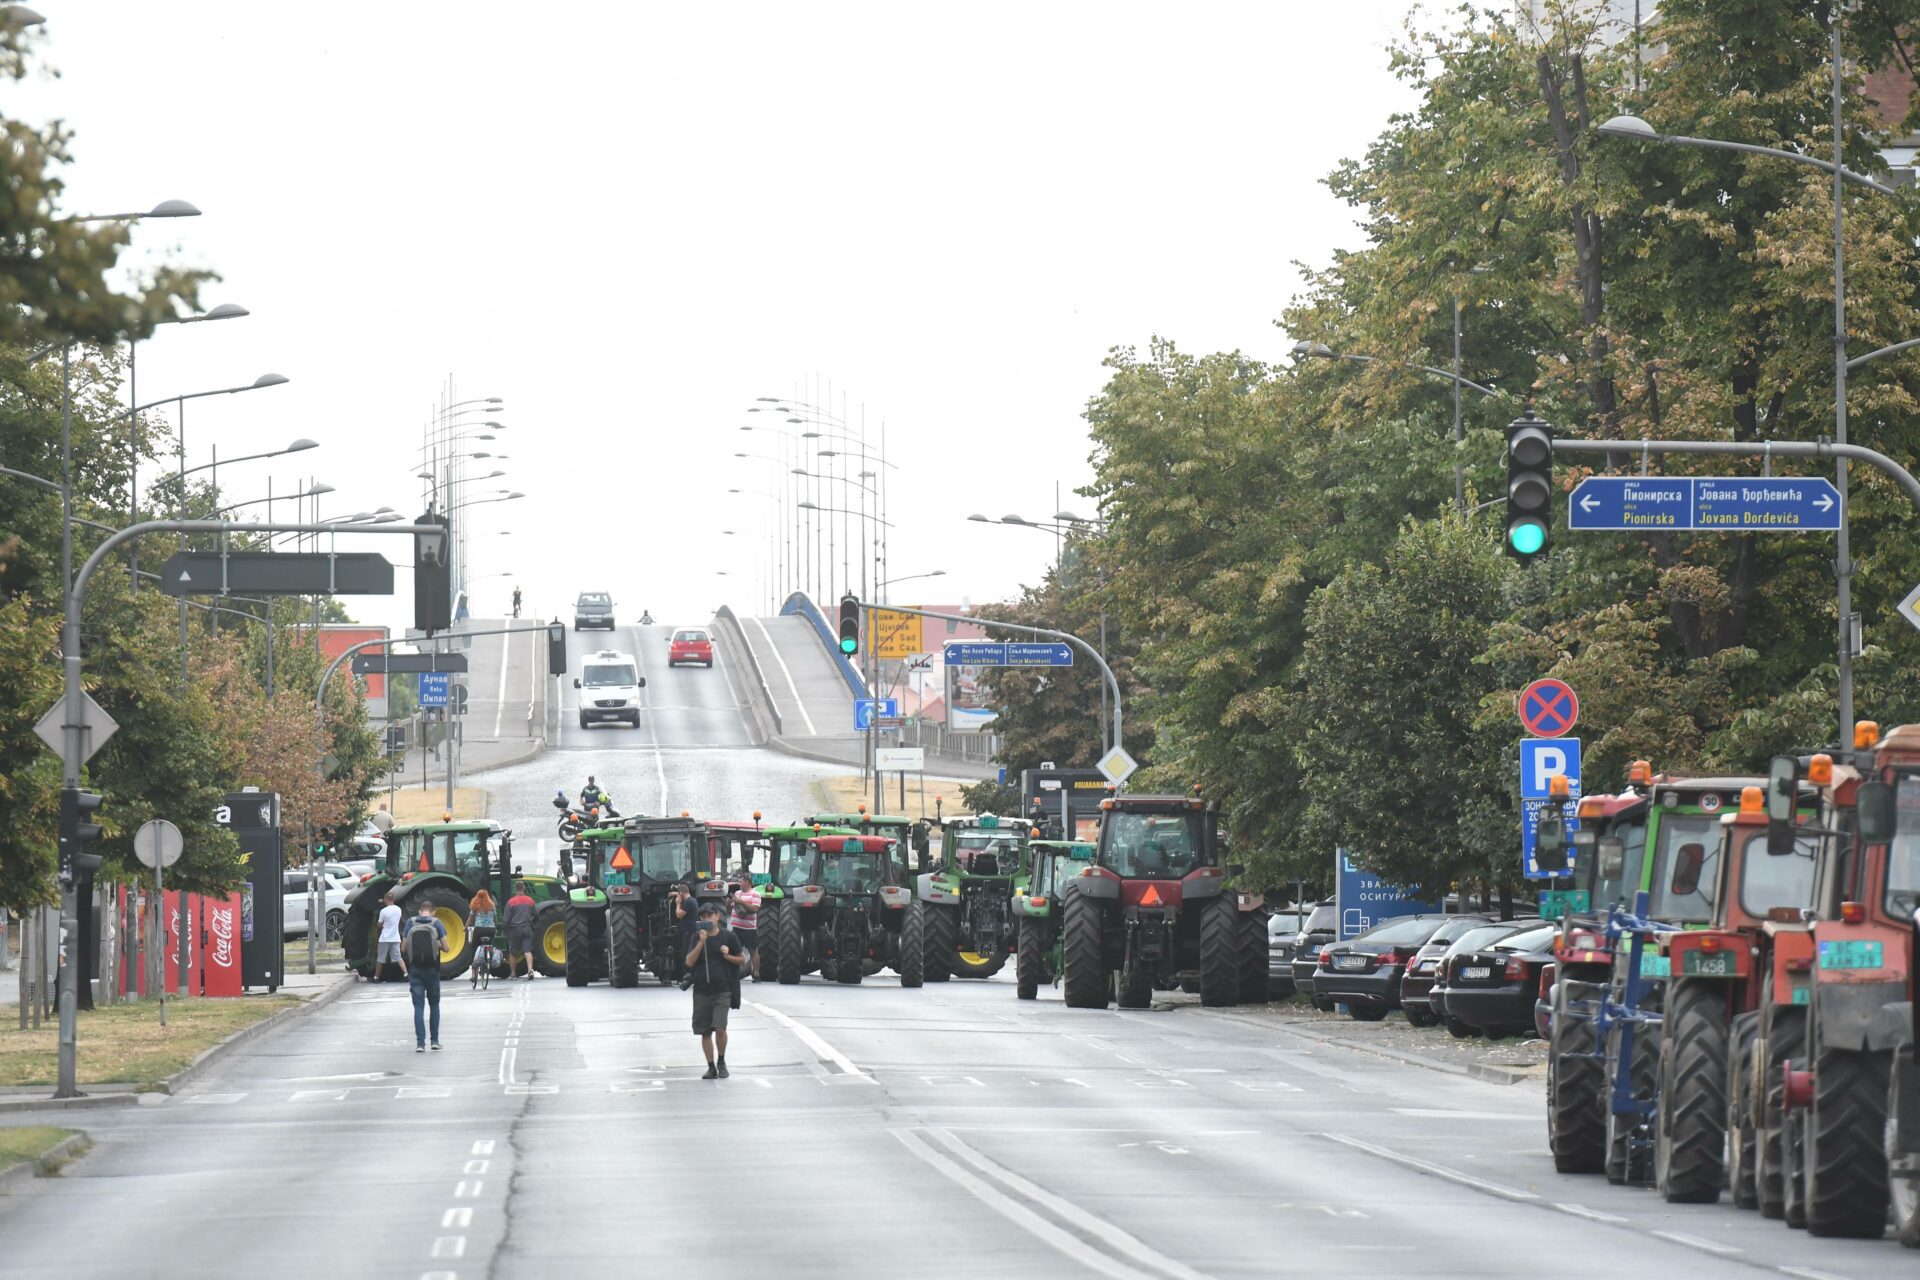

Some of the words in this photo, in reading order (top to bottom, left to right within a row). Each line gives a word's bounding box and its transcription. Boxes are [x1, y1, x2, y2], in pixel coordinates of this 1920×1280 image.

[1623, 488, 1682, 504] Пионирска
[1699, 488, 1738, 501] Јована
[1742, 488, 1803, 503] Ђорђевића
[1623, 512, 1675, 525] Pionirska
[1698, 511, 1739, 524] Jovana
[1743, 511, 1800, 524] Đorđevića
[423, 675, 448, 684] Дунав
[424, 693, 447, 702] Dunav
[1704, 796, 1717, 806] 30
[1694, 959, 1726, 974] 1458
